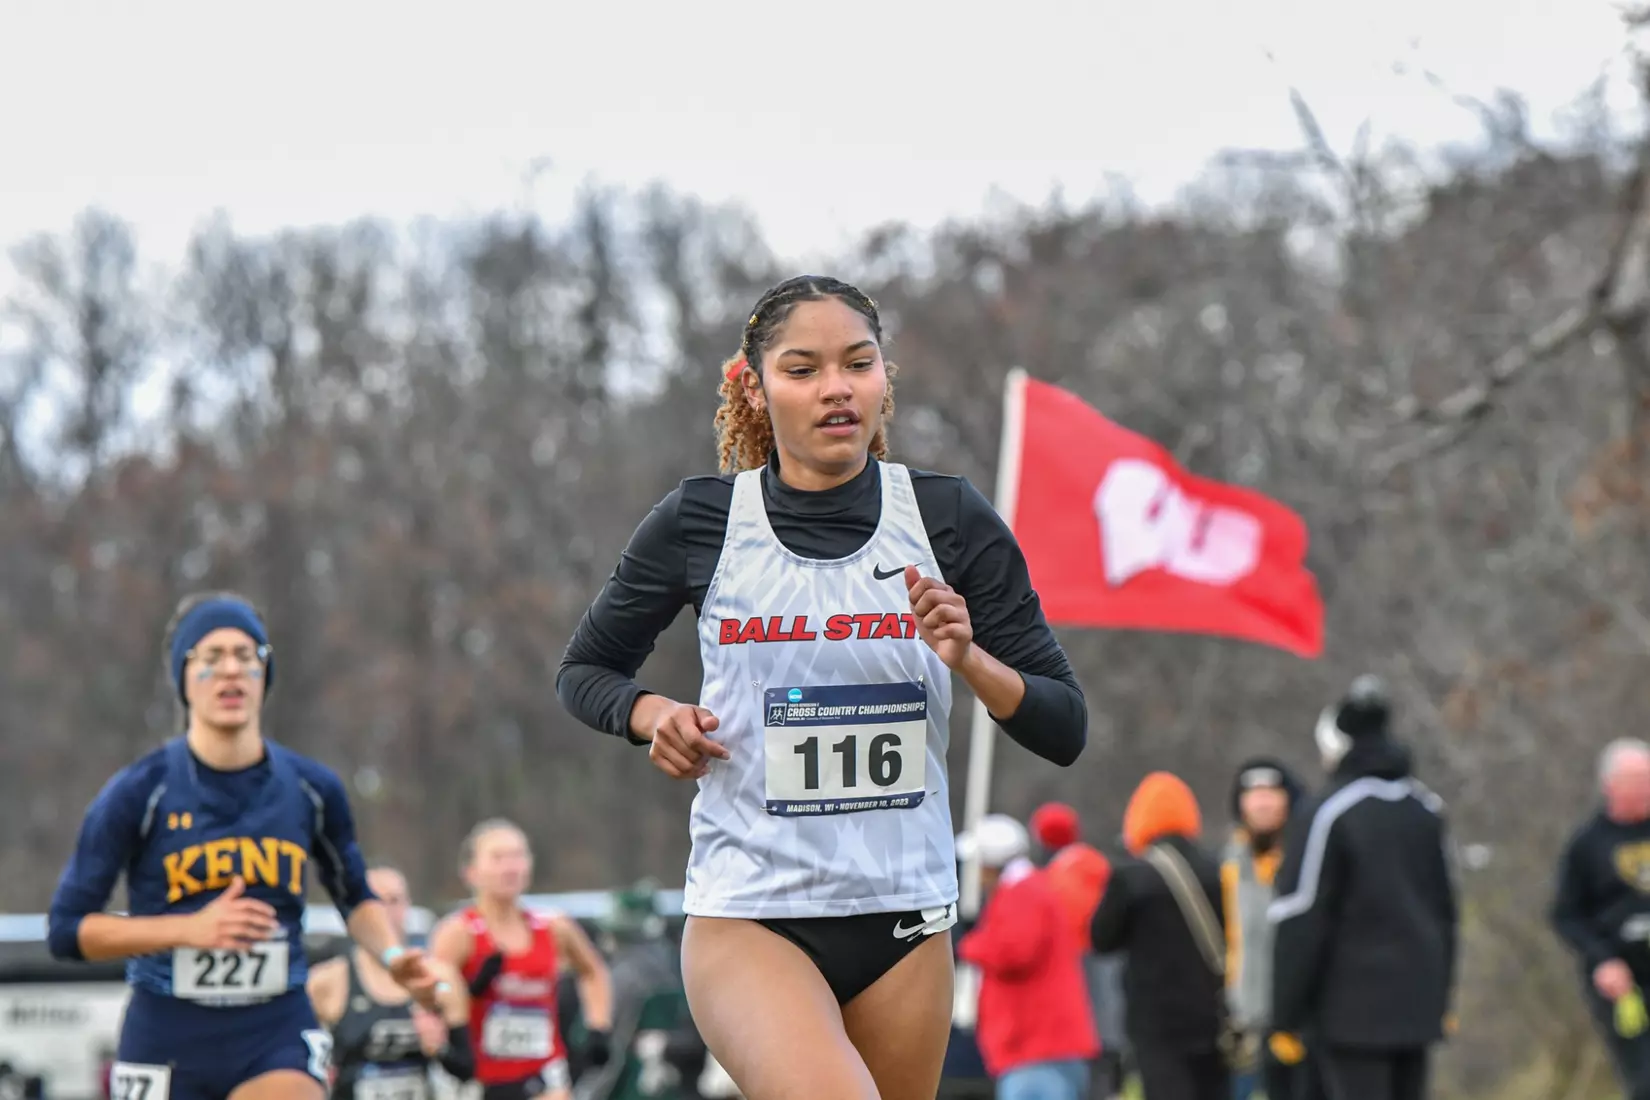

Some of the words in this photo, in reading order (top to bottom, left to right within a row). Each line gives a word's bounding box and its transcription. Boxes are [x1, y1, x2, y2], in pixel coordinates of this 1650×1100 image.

[719, 615, 817, 645] BALL
[823, 613, 922, 641] STAT
[787, 707, 816, 717] CROSS
[817, 705, 857, 717] COUNTRY
[858, 701, 926, 716] CHAMPIONSHIPS
[794, 733, 903, 790] 116
[786, 804, 822, 813] MADISON,
[824, 803, 835, 811] WI
[839, 800, 878, 811] NOVEMBER
[890, 798, 909, 807] 2023
[162, 837, 308, 903] KENT
[195, 950, 269, 987] 227
